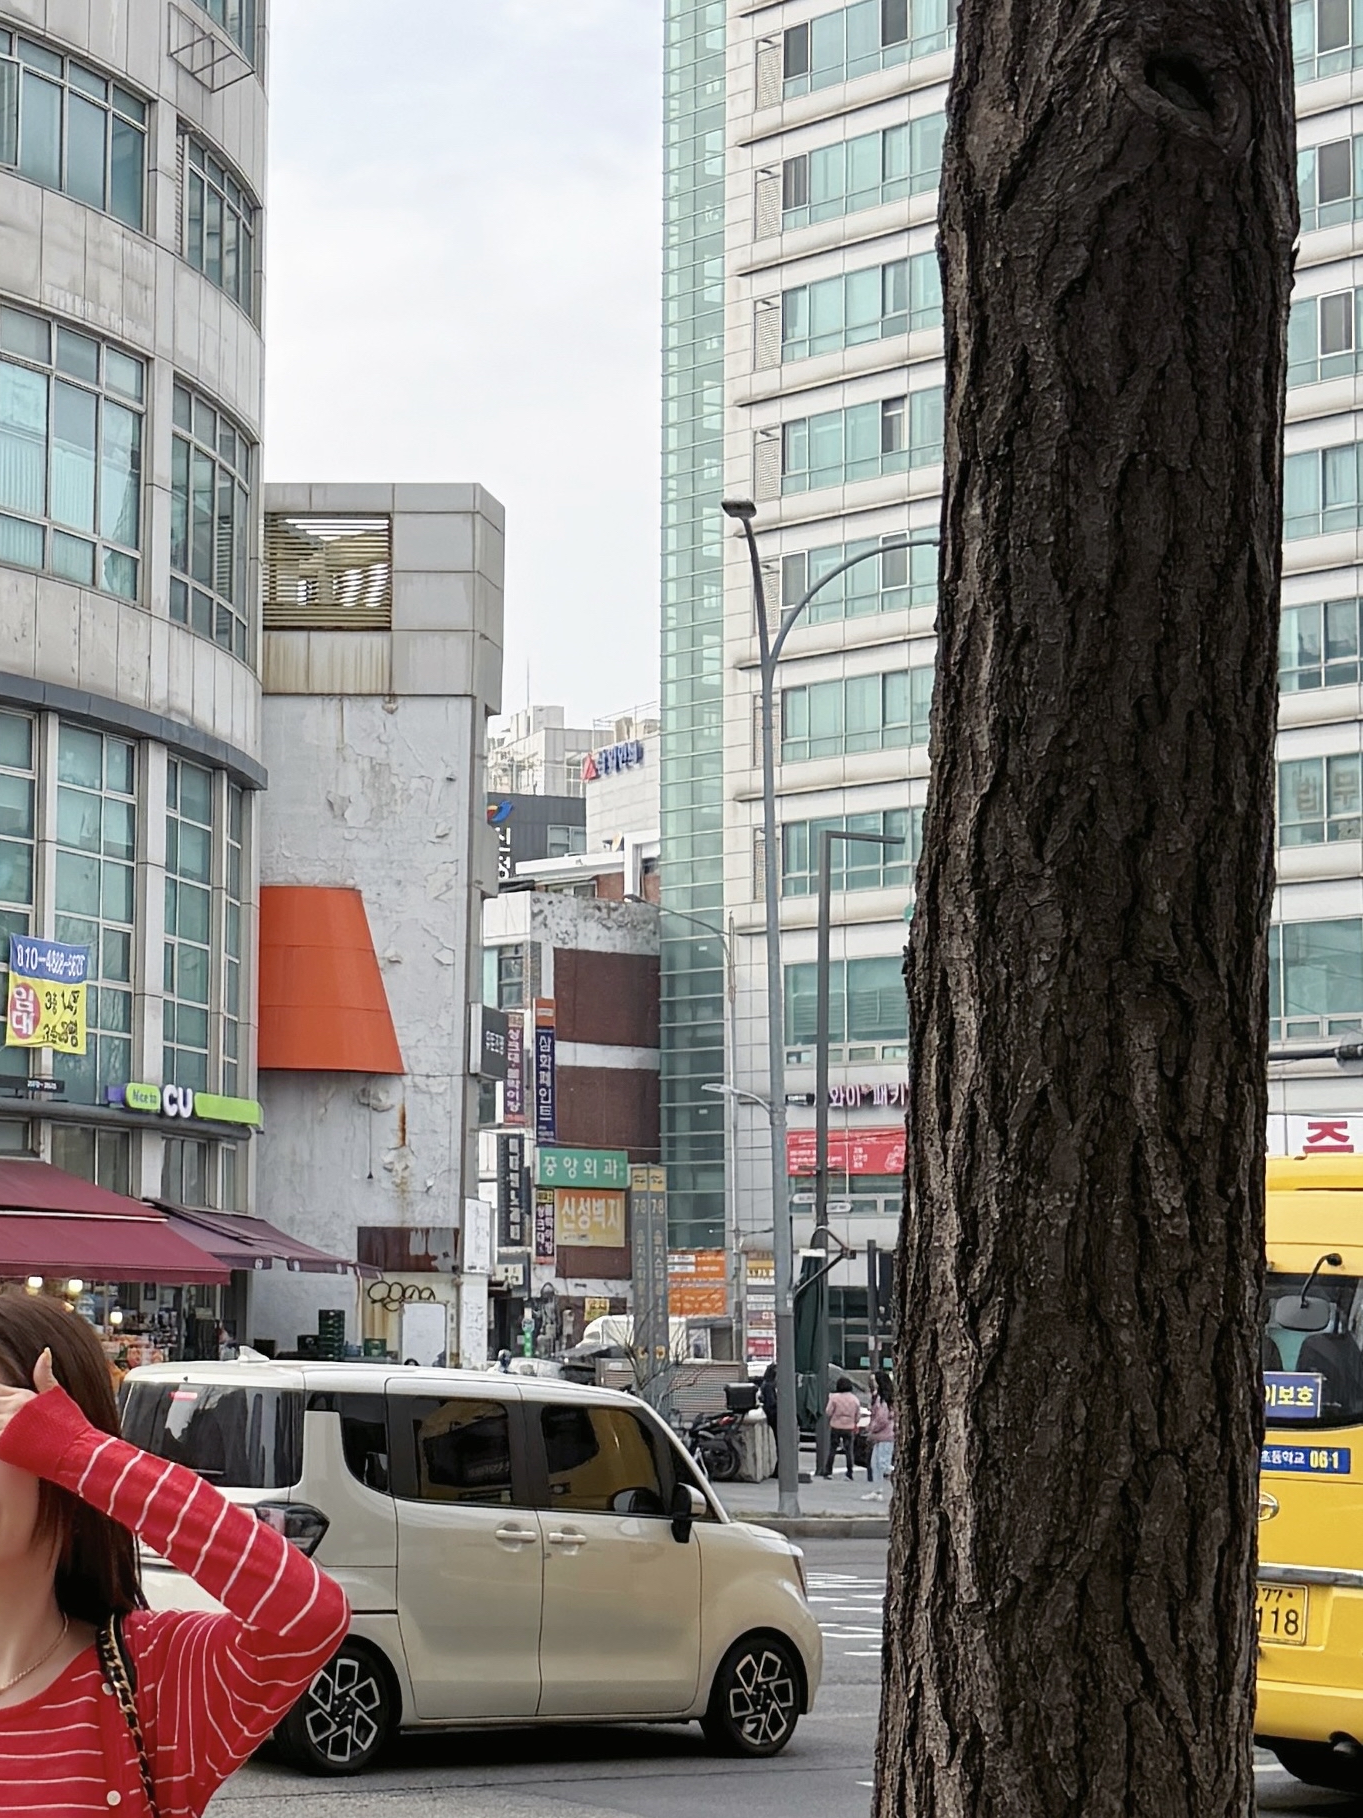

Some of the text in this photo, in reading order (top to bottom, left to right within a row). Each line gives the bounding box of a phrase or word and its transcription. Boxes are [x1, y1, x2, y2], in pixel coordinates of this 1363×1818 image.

[13, 986, 35, 1035] 임대
[163, 1084, 193, 1118] CU
[543, 1156, 618, 1180] 중앙외과
